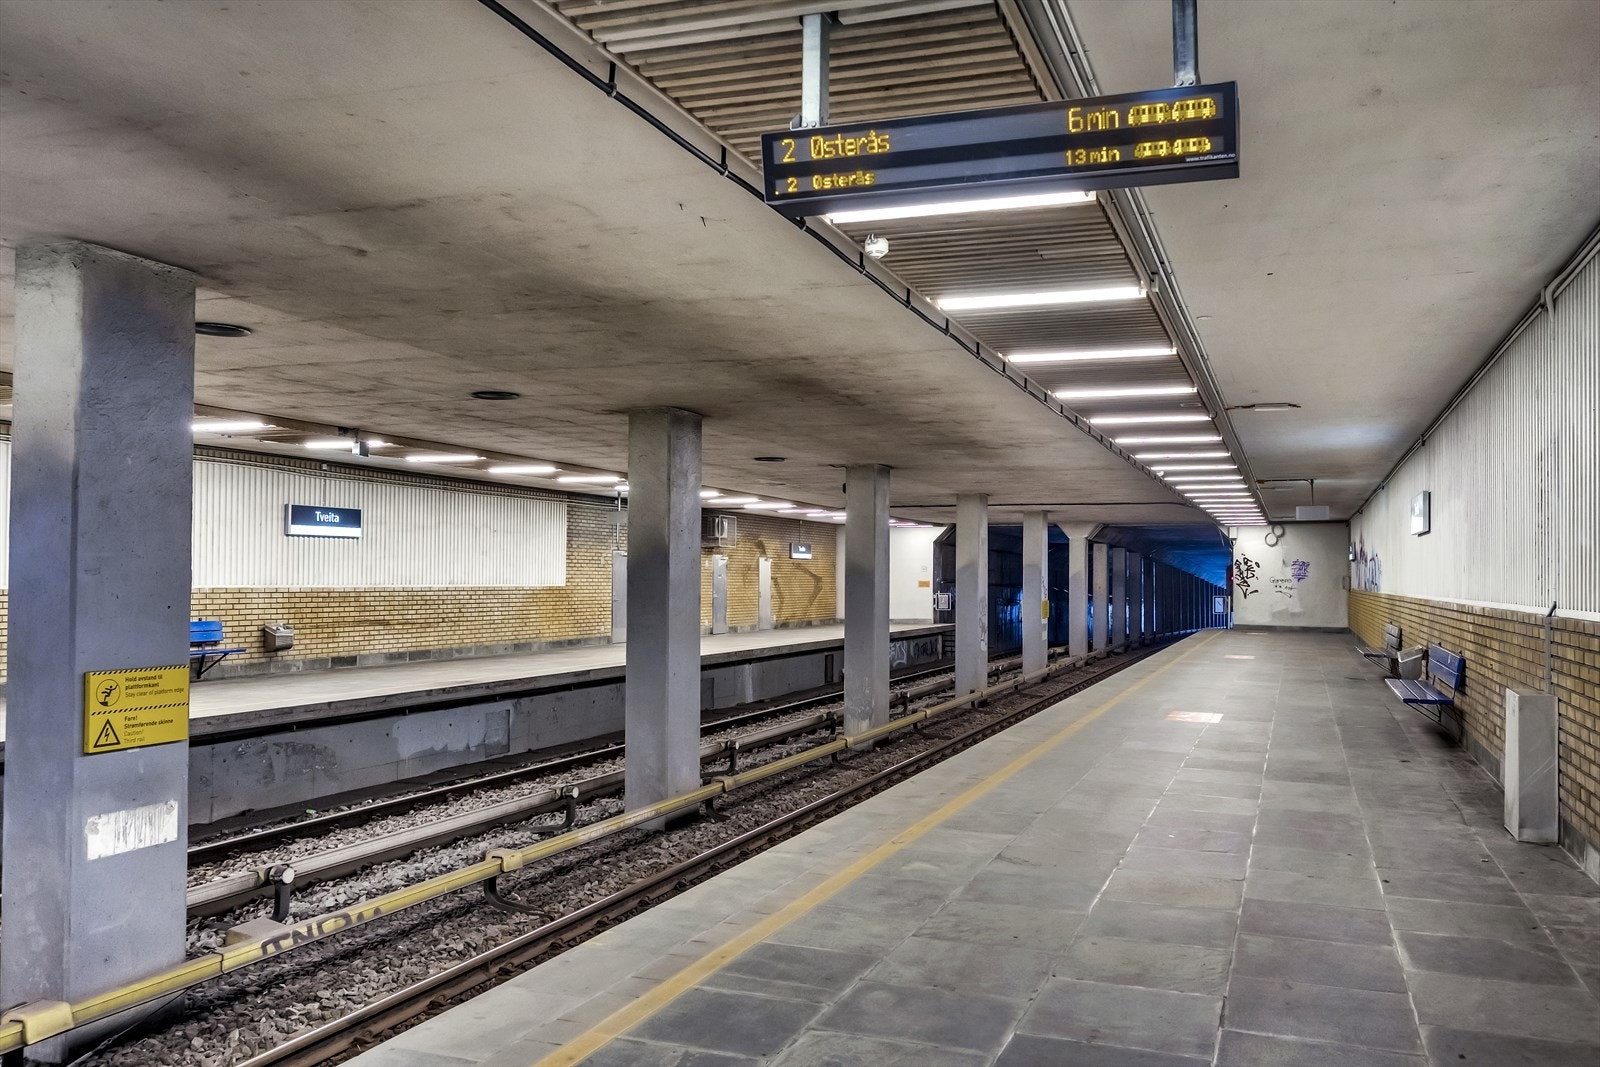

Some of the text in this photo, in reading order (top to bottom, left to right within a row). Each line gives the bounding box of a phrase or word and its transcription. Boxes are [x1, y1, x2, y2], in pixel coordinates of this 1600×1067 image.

[781, 138, 796, 163] 2
[810, 129, 890, 160] Østerås
[787, 177, 798, 193] 2
[315, 511, 339, 523] Tveita
